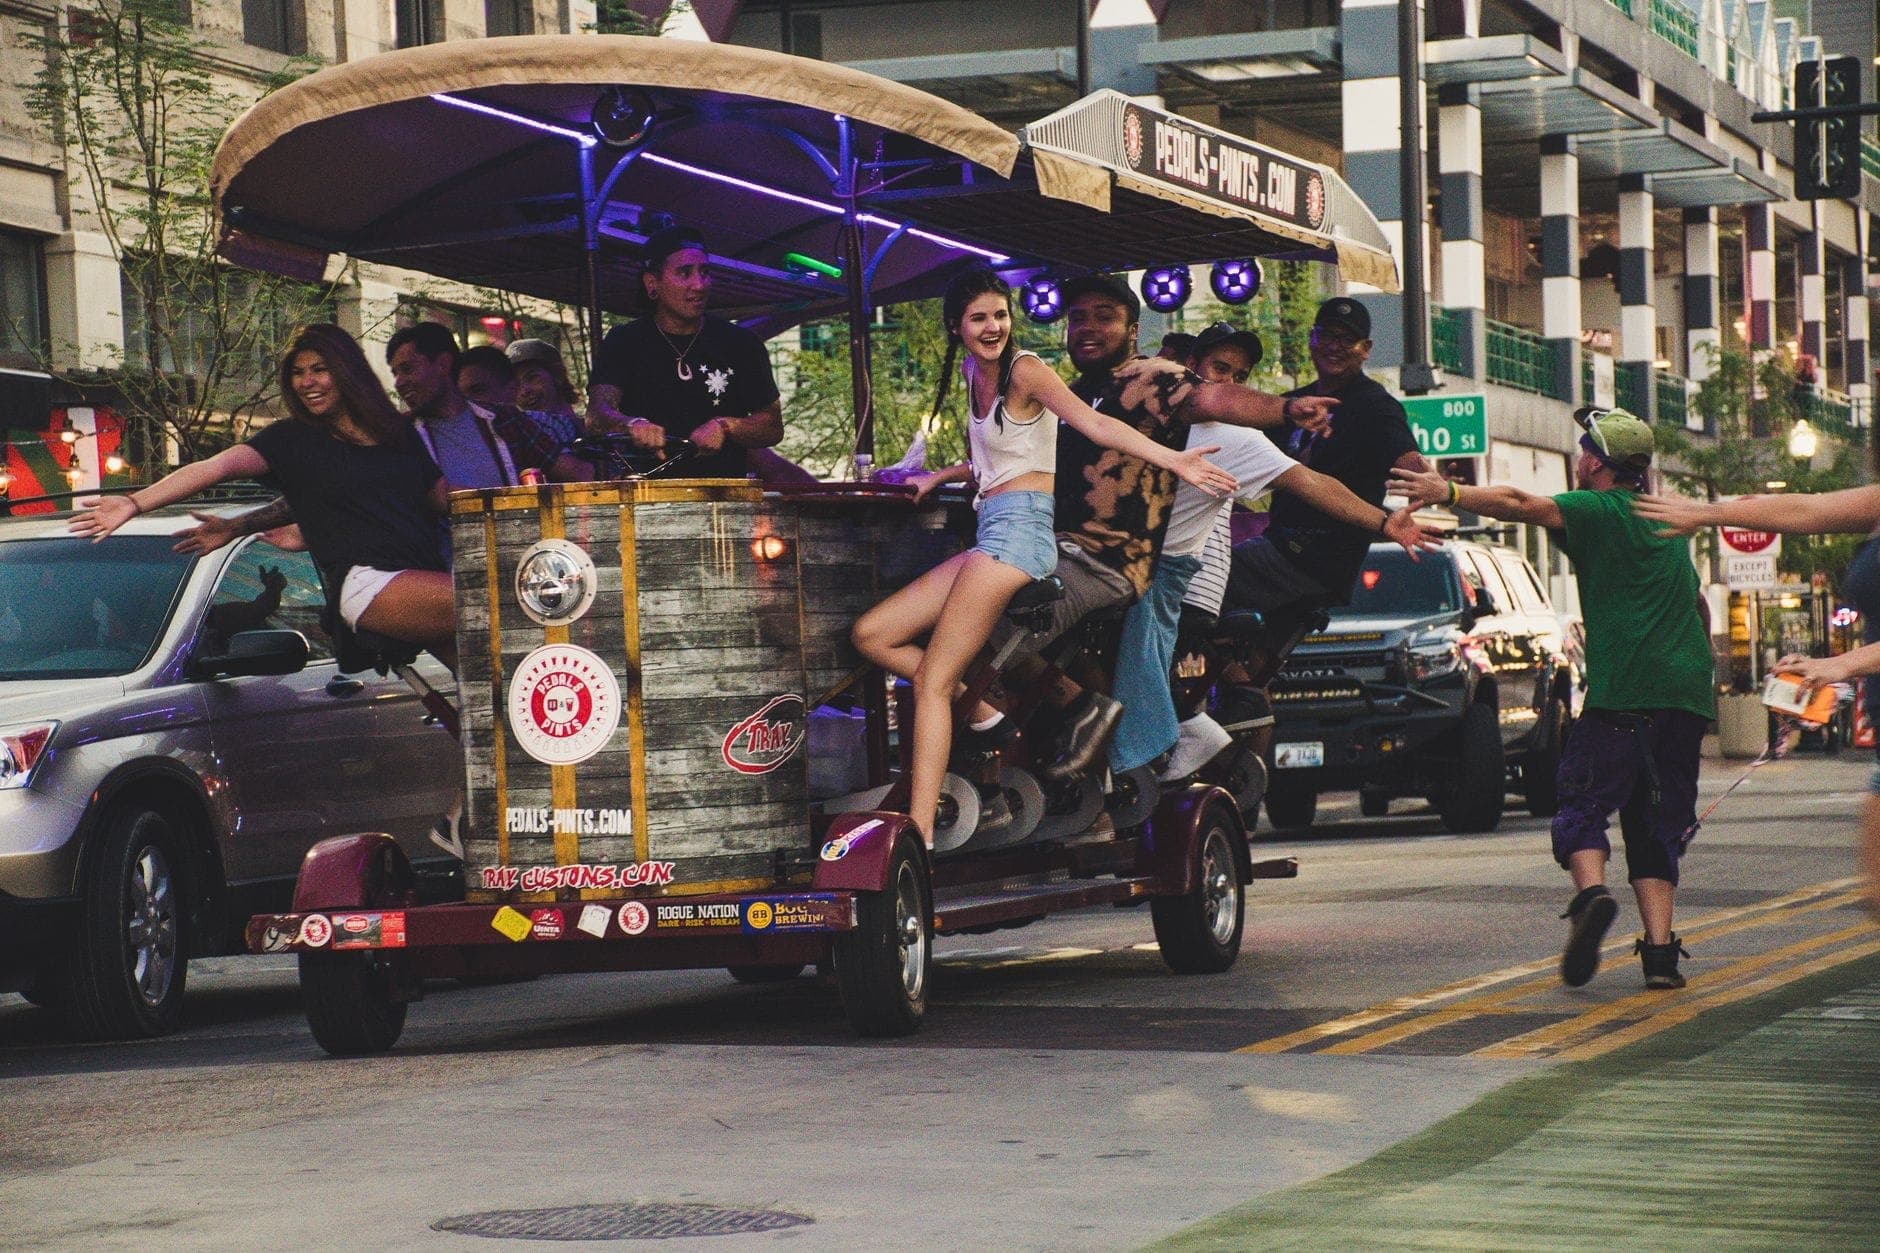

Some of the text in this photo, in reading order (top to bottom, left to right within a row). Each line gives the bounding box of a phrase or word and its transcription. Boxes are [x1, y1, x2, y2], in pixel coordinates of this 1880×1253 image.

[1443, 400, 1475, 417] 800
[1412, 422, 1476, 452] ho St
[1733, 532, 1767, 543] ENTER
[1734, 561, 1767, 571] EXCEPT
[1730, 574, 1774, 583] BICYCLES
[537, 673, 585, 695] PEDALS
[541, 718, 583, 737] PINTS
[505, 807, 633, 834] PEDALS-PINTS.COM
[657, 905, 694, 920] ROGUE
[698, 903, 740, 919] NATION
[775, 913, 824, 925] BREWIN
[685, 919, 705, 927] RISK
[710, 918, 741, 926] DREAM
